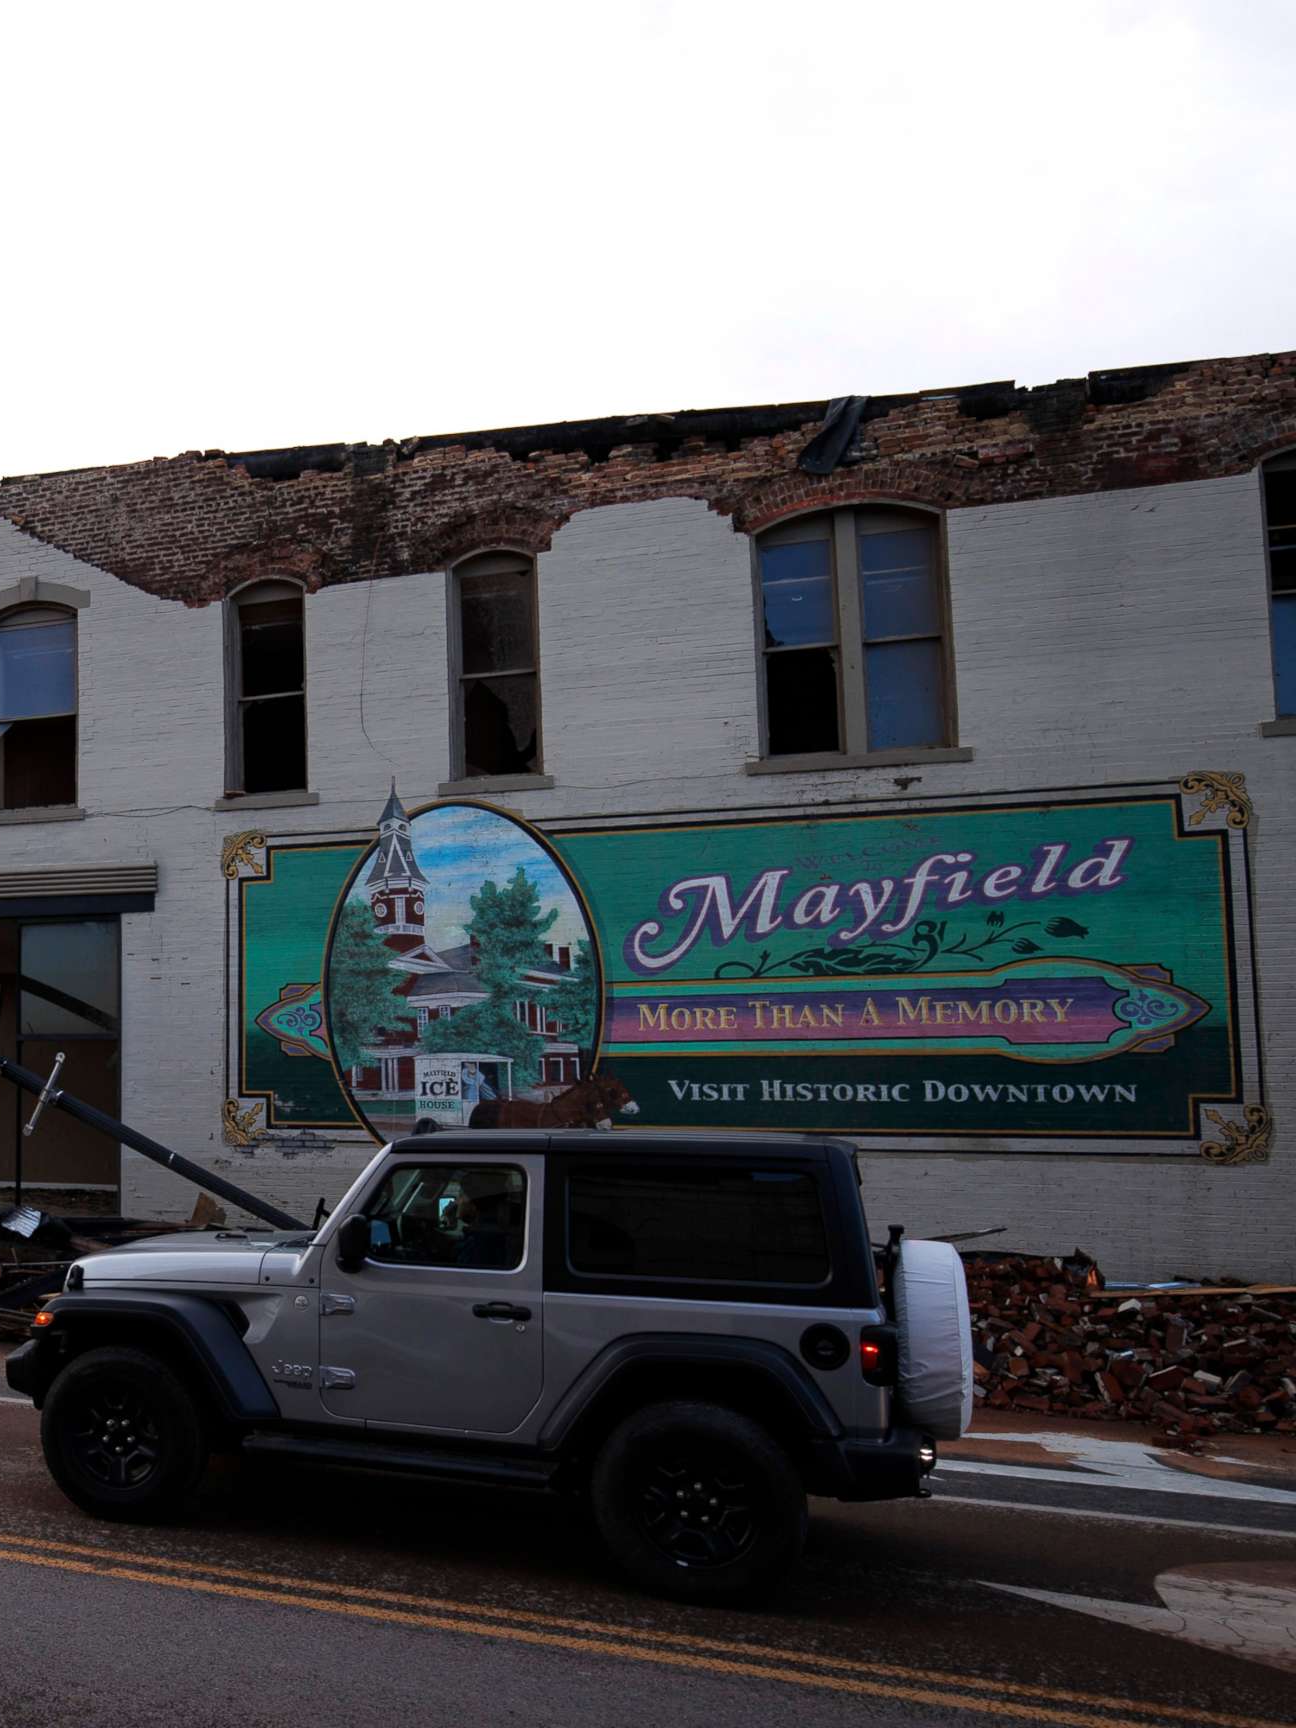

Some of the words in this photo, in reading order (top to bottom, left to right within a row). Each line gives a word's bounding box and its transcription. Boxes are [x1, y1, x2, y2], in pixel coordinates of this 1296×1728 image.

[632, 838, 1131, 968] Mayfield
[636, 1003, 738, 1032] MORE
[748, 1000, 845, 1030] THAN
[858, 996, 884, 1026] A
[895, 996, 1075, 1026] MEMORY
[420, 1080, 459, 1097] ICE
[667, 1079, 750, 1101] VISIT
[759, 1079, 910, 1102] HISTORIC
[921, 1079, 1139, 1103] DOWNTOWN
[420, 1101, 456, 1110] HOUSE
